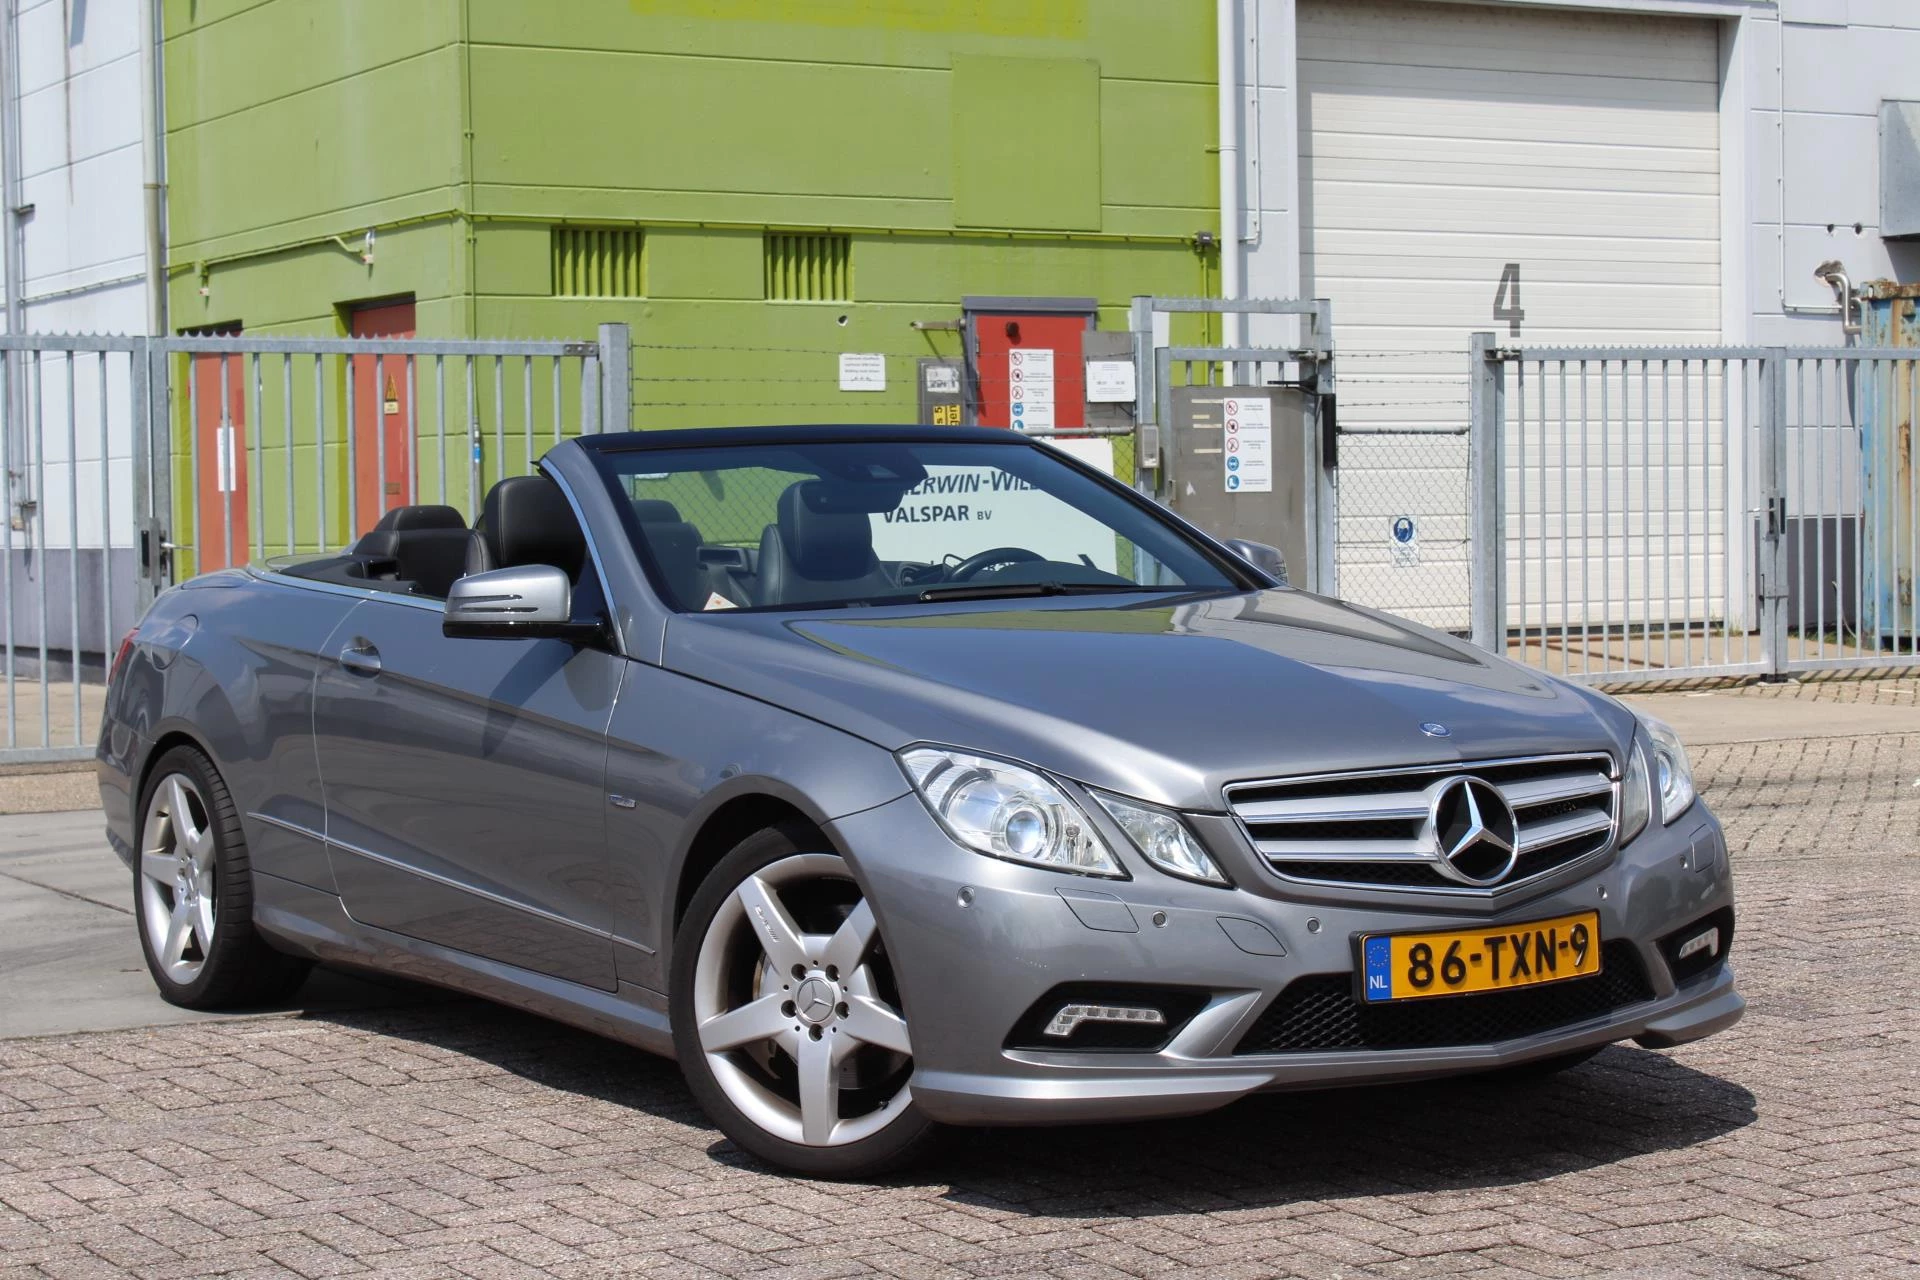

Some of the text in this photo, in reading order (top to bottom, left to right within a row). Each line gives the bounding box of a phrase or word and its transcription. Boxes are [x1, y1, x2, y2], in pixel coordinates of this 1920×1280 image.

[1493, 263, 1525, 338] 4
[884, 504, 992, 524] VALSPAR BV
[1369, 922, 1590, 990] NL 86-TXN-9
